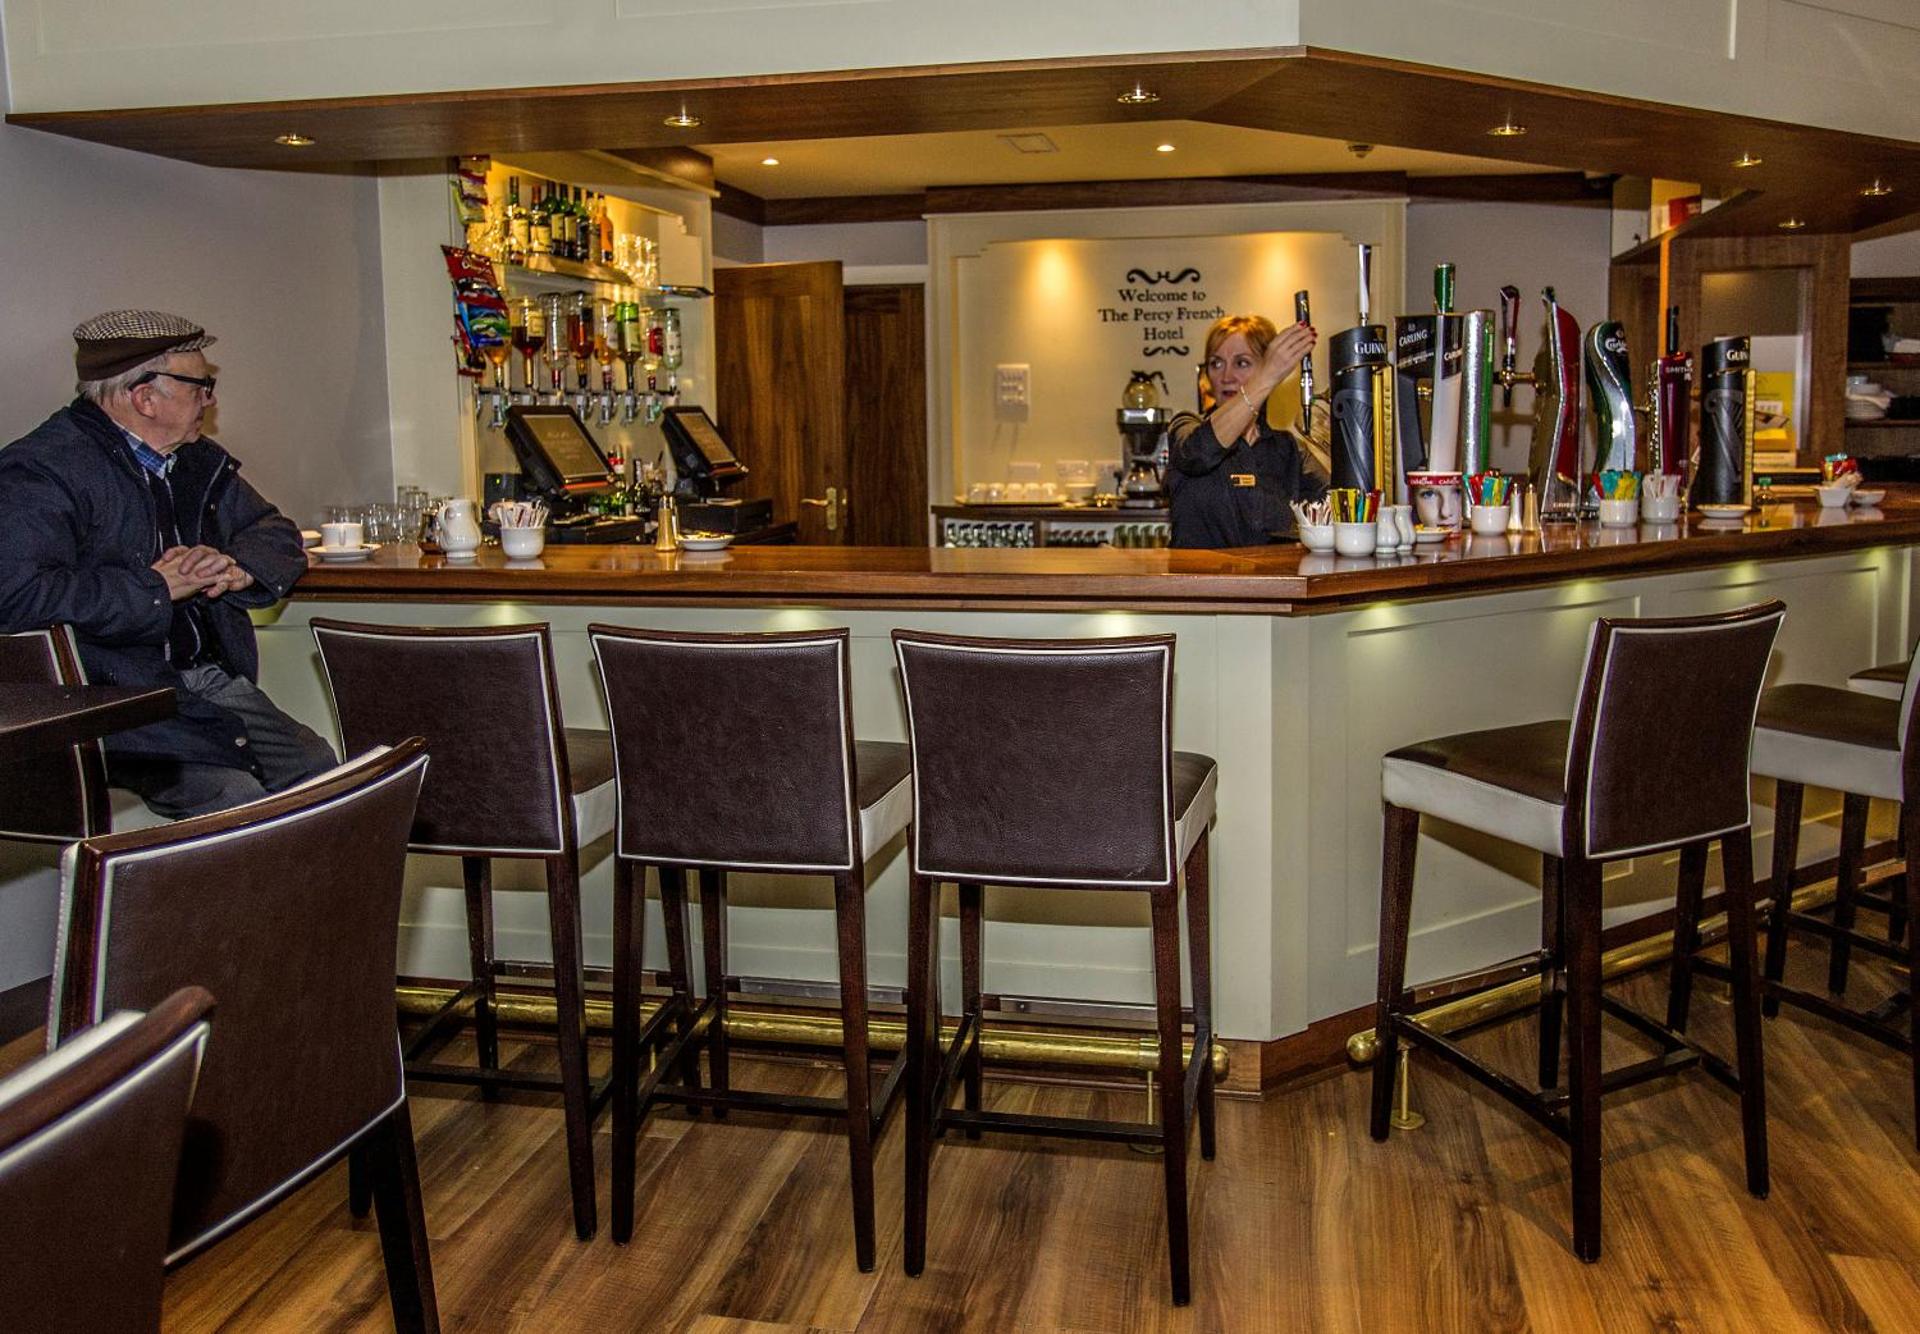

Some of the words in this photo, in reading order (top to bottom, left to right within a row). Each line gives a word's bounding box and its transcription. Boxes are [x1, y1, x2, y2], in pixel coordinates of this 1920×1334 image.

[1118, 289, 1188, 302] Welcome
[1192, 290, 1206, 302] to
[1098, 308, 1129, 322] The
[1134, 308, 1173, 323] Percy
[1177, 306, 1225, 320] French
[1143, 327, 1184, 341] Hotel
[1399, 329, 1428, 347] CARLING
